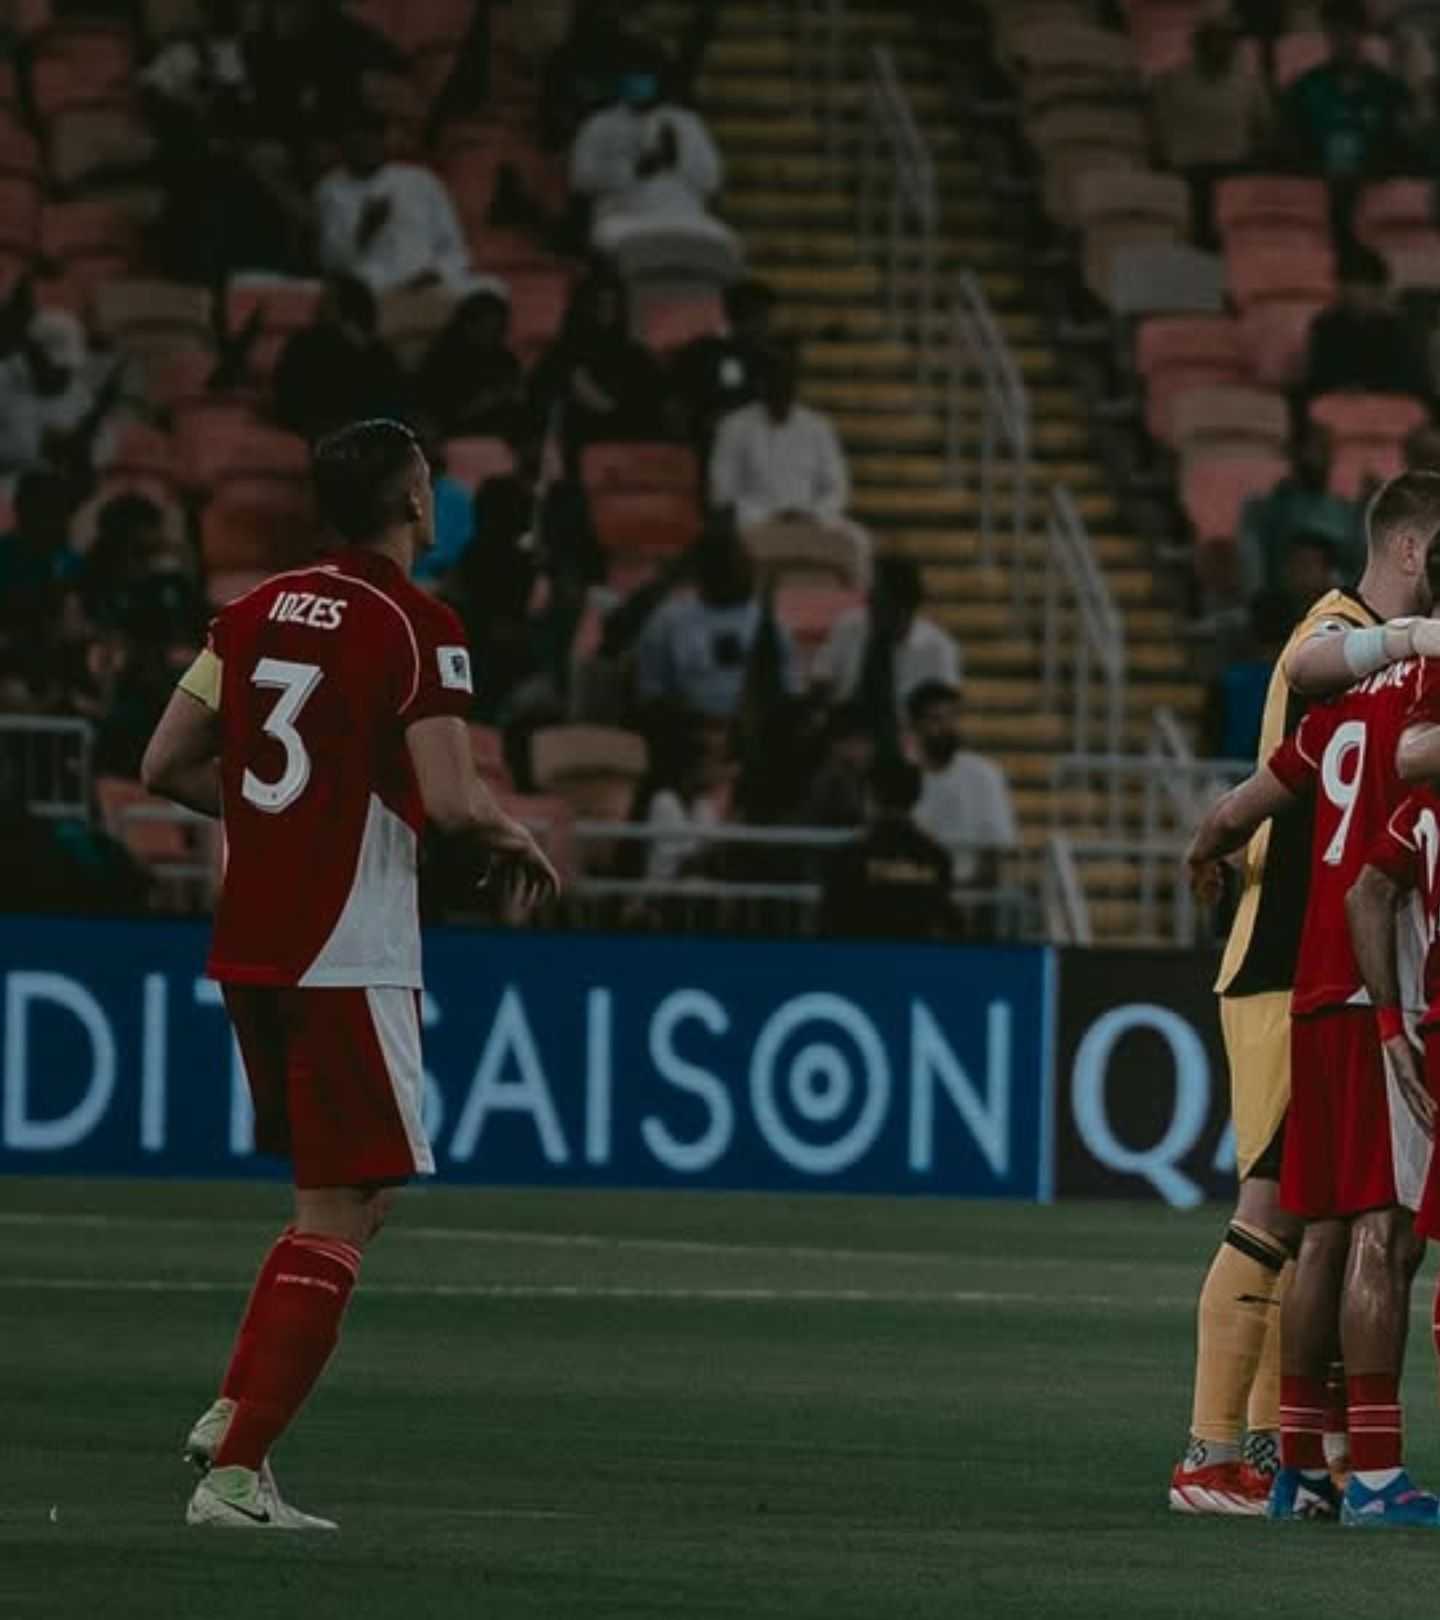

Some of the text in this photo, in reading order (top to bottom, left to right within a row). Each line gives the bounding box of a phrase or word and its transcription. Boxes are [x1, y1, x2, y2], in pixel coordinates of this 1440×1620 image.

[267, 591, 349, 630] IDZES
[241, 657, 325, 814] 3
[1321, 719, 1367, 865] 9
